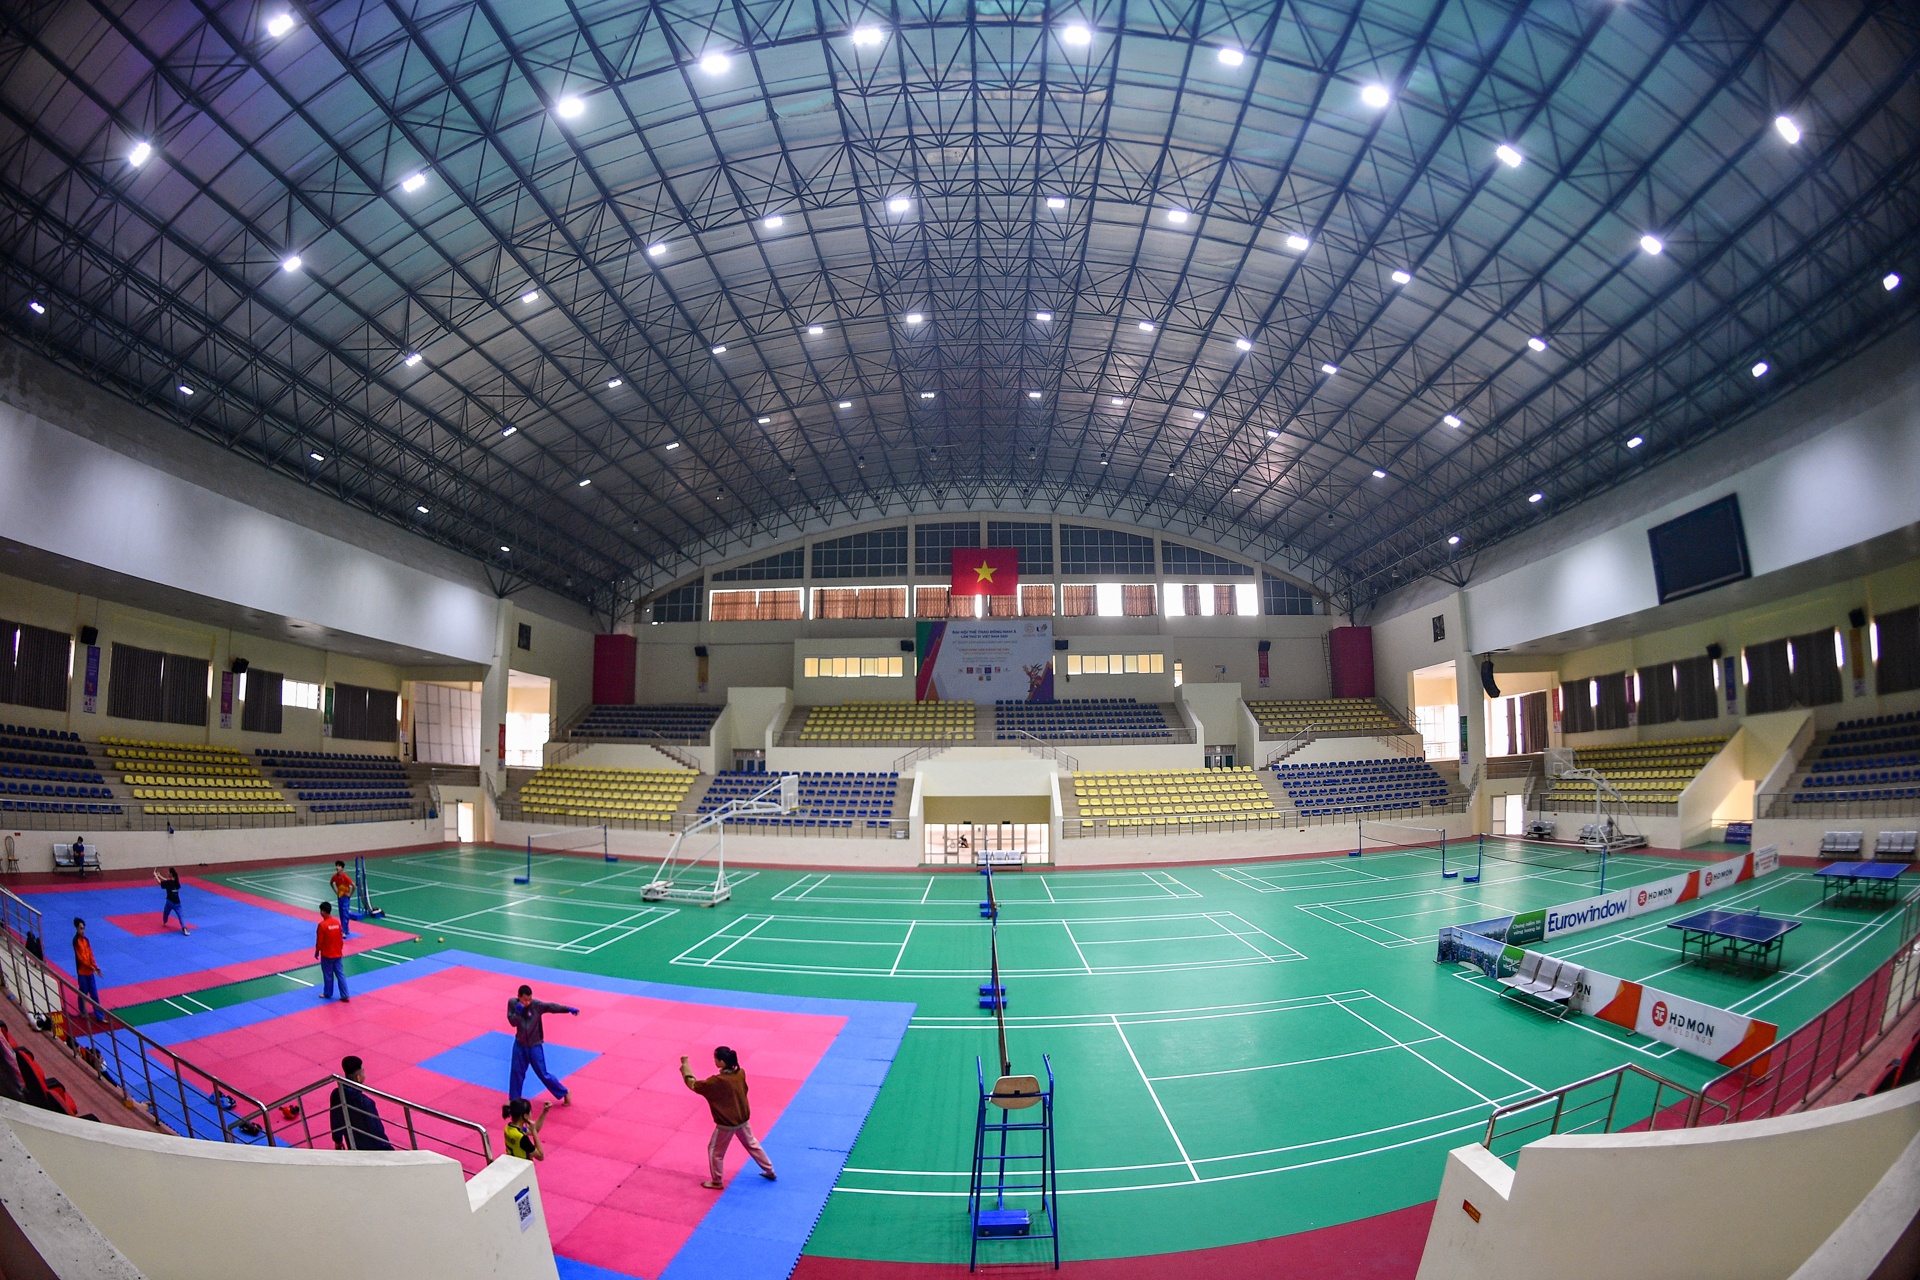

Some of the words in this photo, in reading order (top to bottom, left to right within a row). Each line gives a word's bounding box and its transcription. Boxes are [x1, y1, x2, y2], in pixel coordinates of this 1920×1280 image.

[1648, 887, 1673, 900] HDMON
[1548, 900, 1627, 932] Eurowindow
[1668, 1025, 1712, 1046] HOLDINGS
[1669, 1013, 1714, 1037] HDMON
